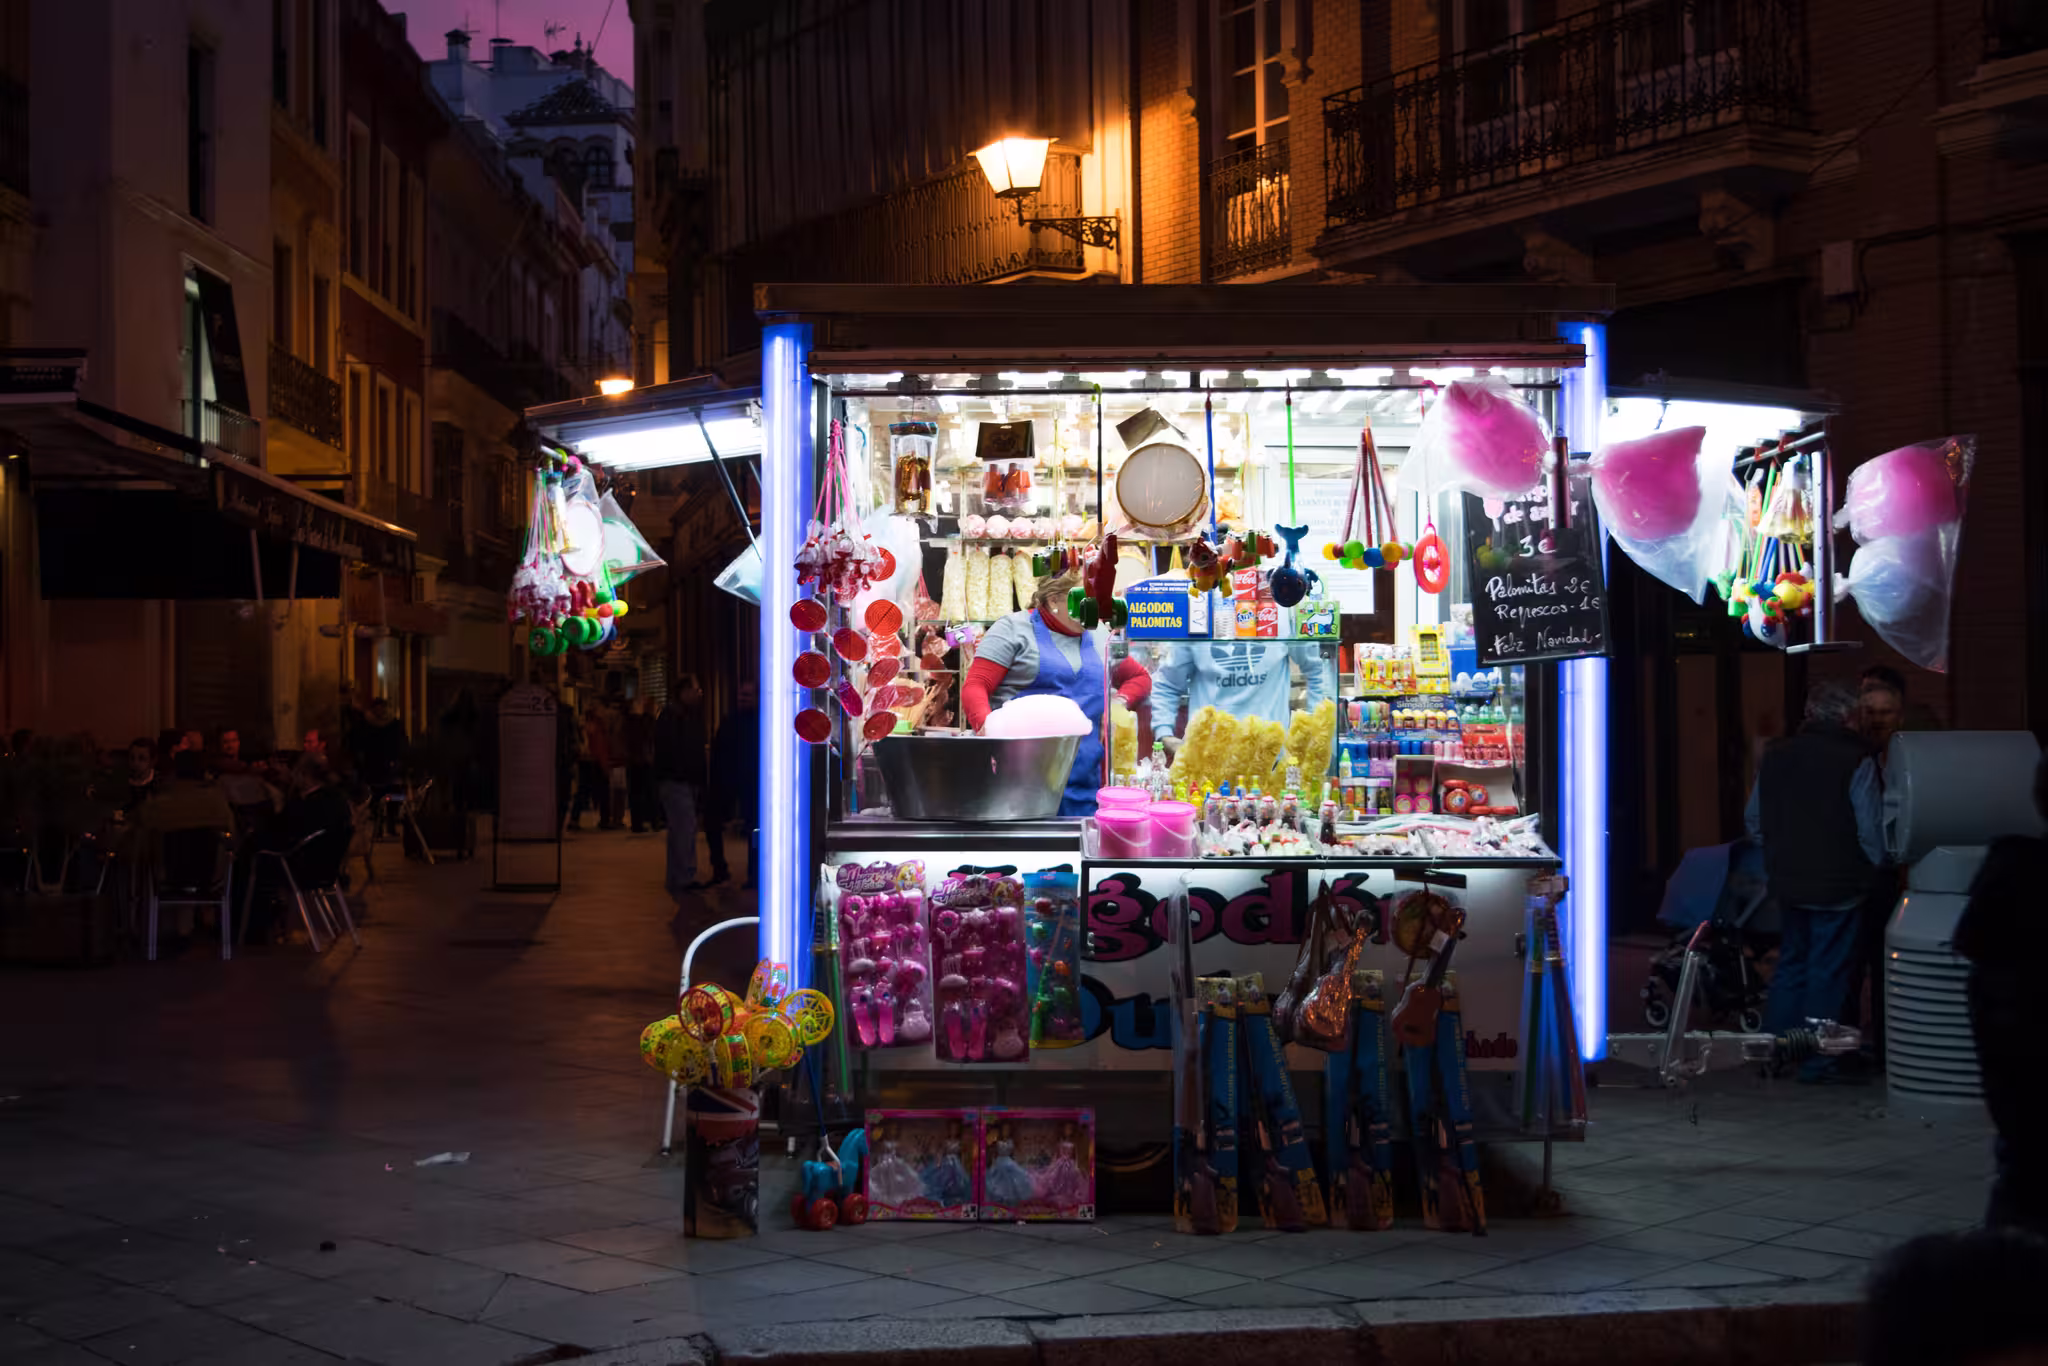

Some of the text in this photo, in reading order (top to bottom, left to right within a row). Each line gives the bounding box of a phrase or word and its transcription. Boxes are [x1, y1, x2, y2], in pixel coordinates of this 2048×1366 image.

[1485, 573, 1557, 601] Palomitas
[1129, 601, 1175, 614] ALGODON
[1494, 604, 1568, 629] Refrescos
[1130, 616, 1183, 628] PALOMITAS
